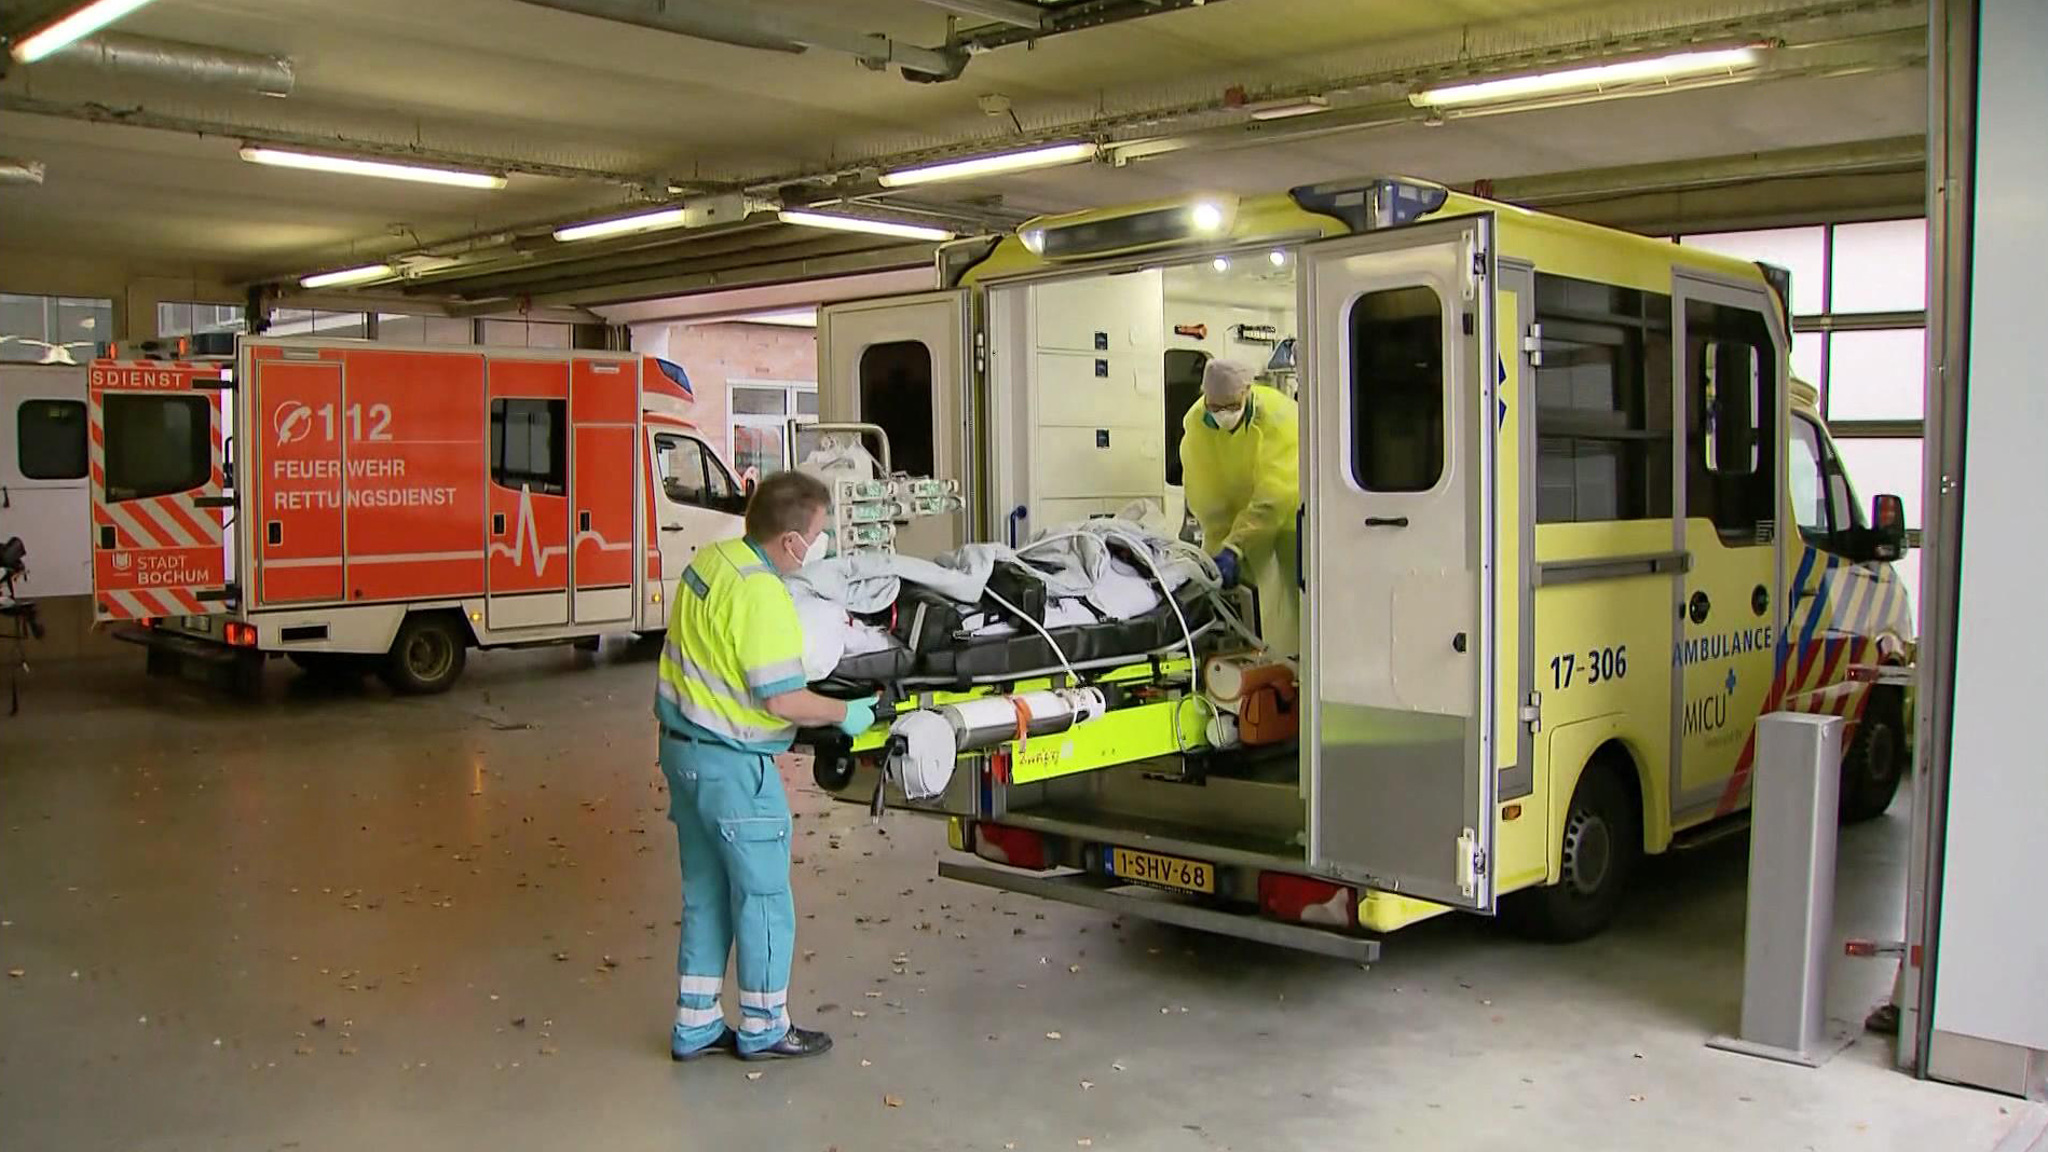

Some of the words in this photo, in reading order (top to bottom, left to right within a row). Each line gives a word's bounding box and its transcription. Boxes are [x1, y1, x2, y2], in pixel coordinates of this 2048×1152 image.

[92, 371, 183, 388] SDIENST
[317, 403, 393, 441] 112
[274, 487, 457, 510] RETTUNGSDIENST
[138, 555, 187, 570] STADT
[138, 570, 209, 584] BOCHUM
[1672, 626, 1771, 667] AMBULANCE
[1550, 645, 1626, 689] 17-306
[1683, 694, 1726, 736] MICU
[1121, 852, 1205, 888] 1-SHV-68
